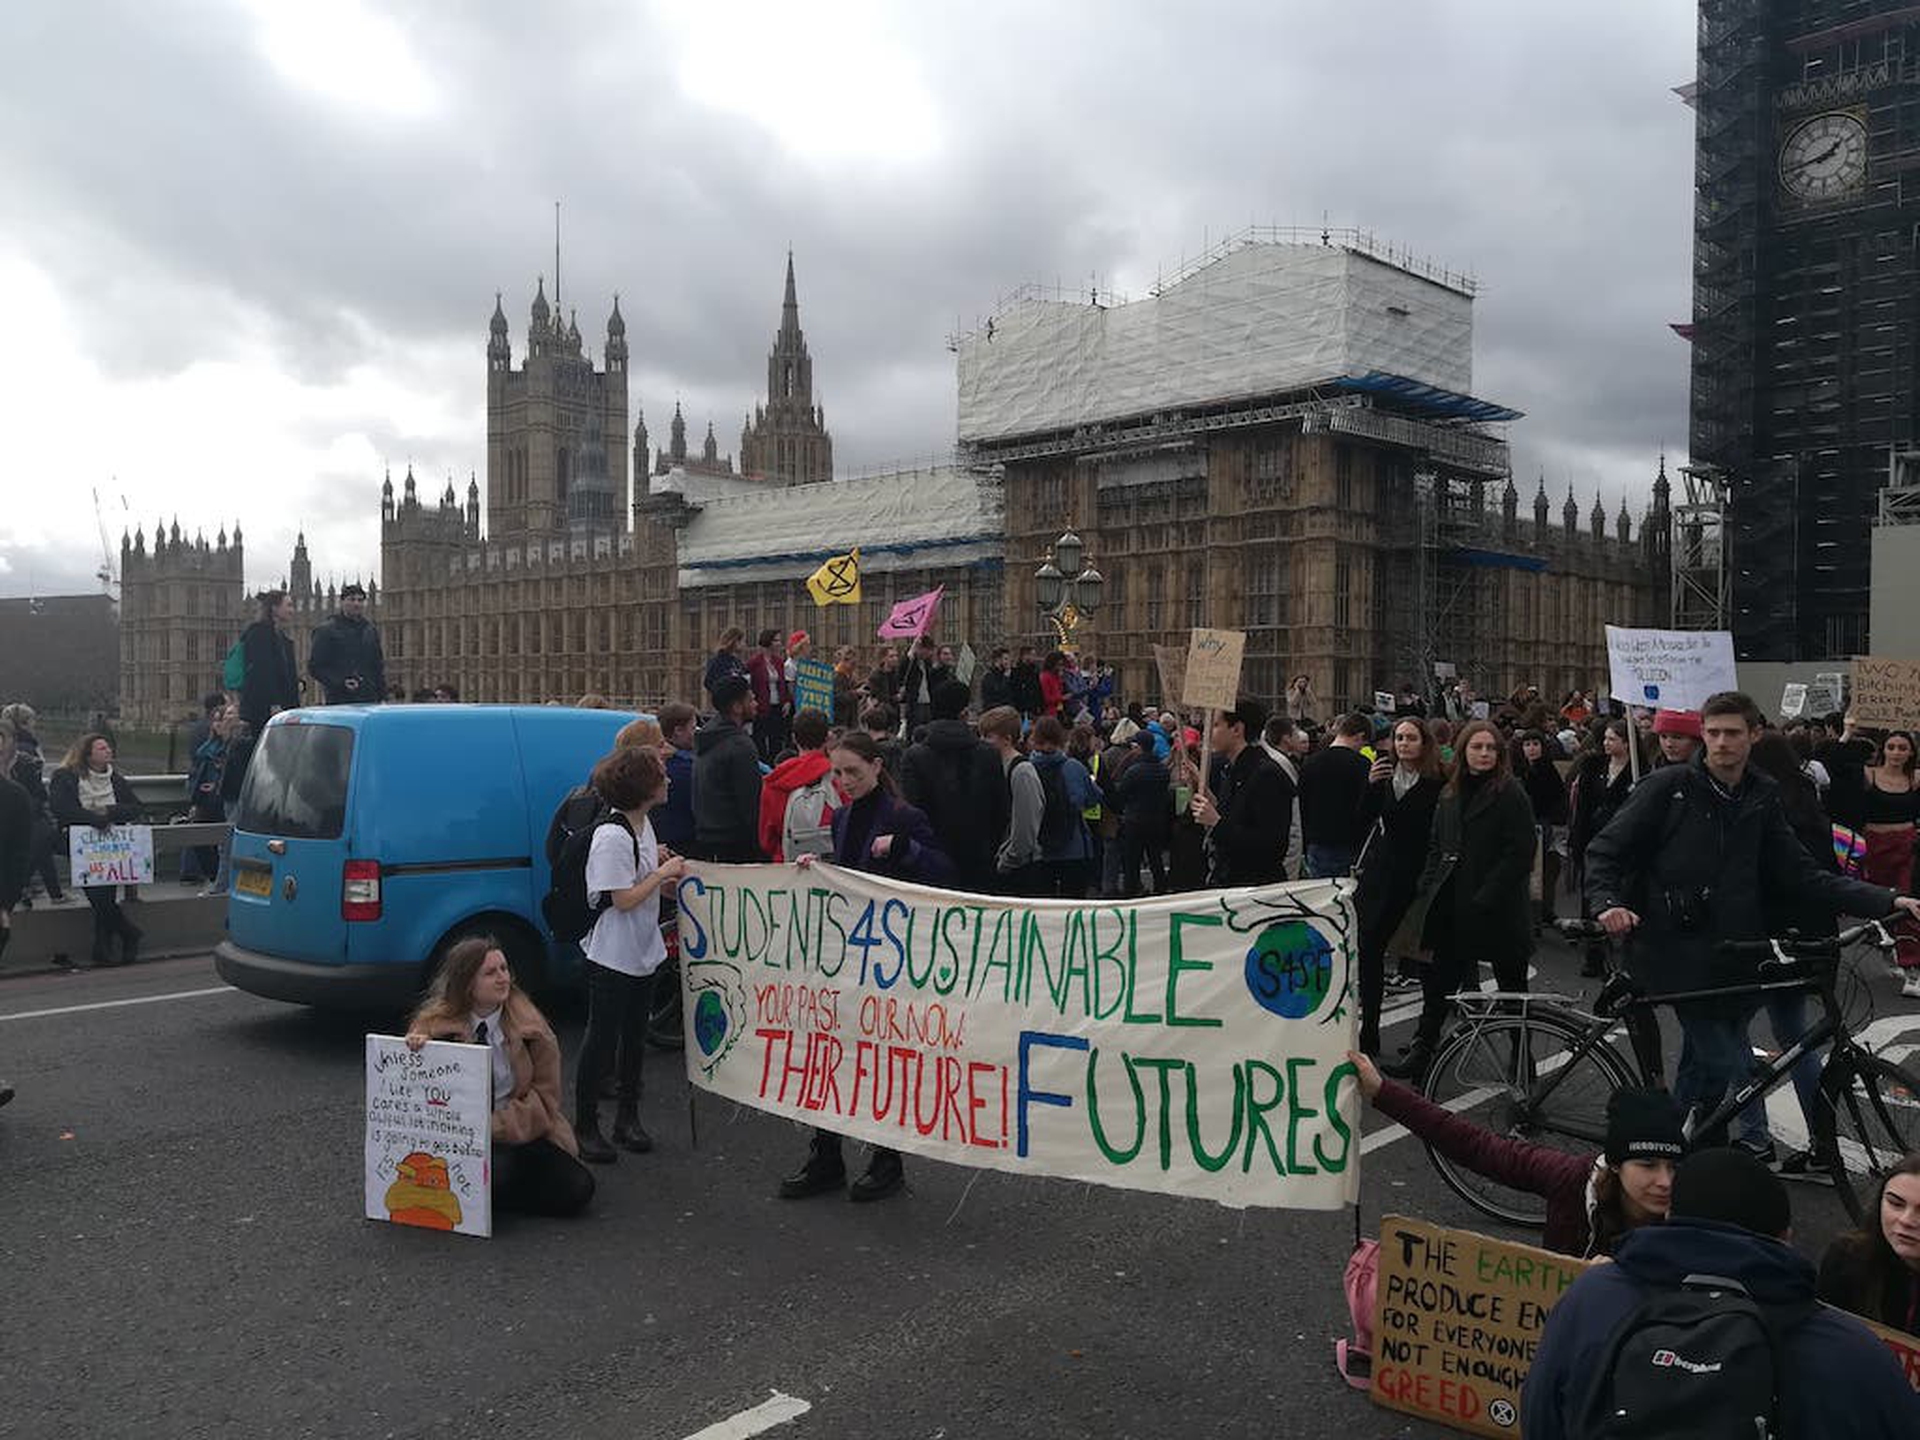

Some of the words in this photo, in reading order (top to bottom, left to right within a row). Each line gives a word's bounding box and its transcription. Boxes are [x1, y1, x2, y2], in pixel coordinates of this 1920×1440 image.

[106, 857, 139, 881] ALL
[754, 984, 793, 1028] YOUR
[799, 986, 841, 1031] PAST.
[859, 995, 904, 1042] OUR
[905, 1002, 965, 1050] NOW.
[849, 1041, 1008, 1149] FUTURE!
[1016, 1030, 1358, 1177] FUTURES
[1395, 1230, 1458, 1277] THE
[1386, 1274, 1502, 1323] PRODUCE
[1381, 1337, 1429, 1366] NOT
[1382, 1307, 1419, 1336] FOR
[1432, 1320, 1538, 1362] EVERYONE
[1377, 1366, 1480, 1420] GREED
